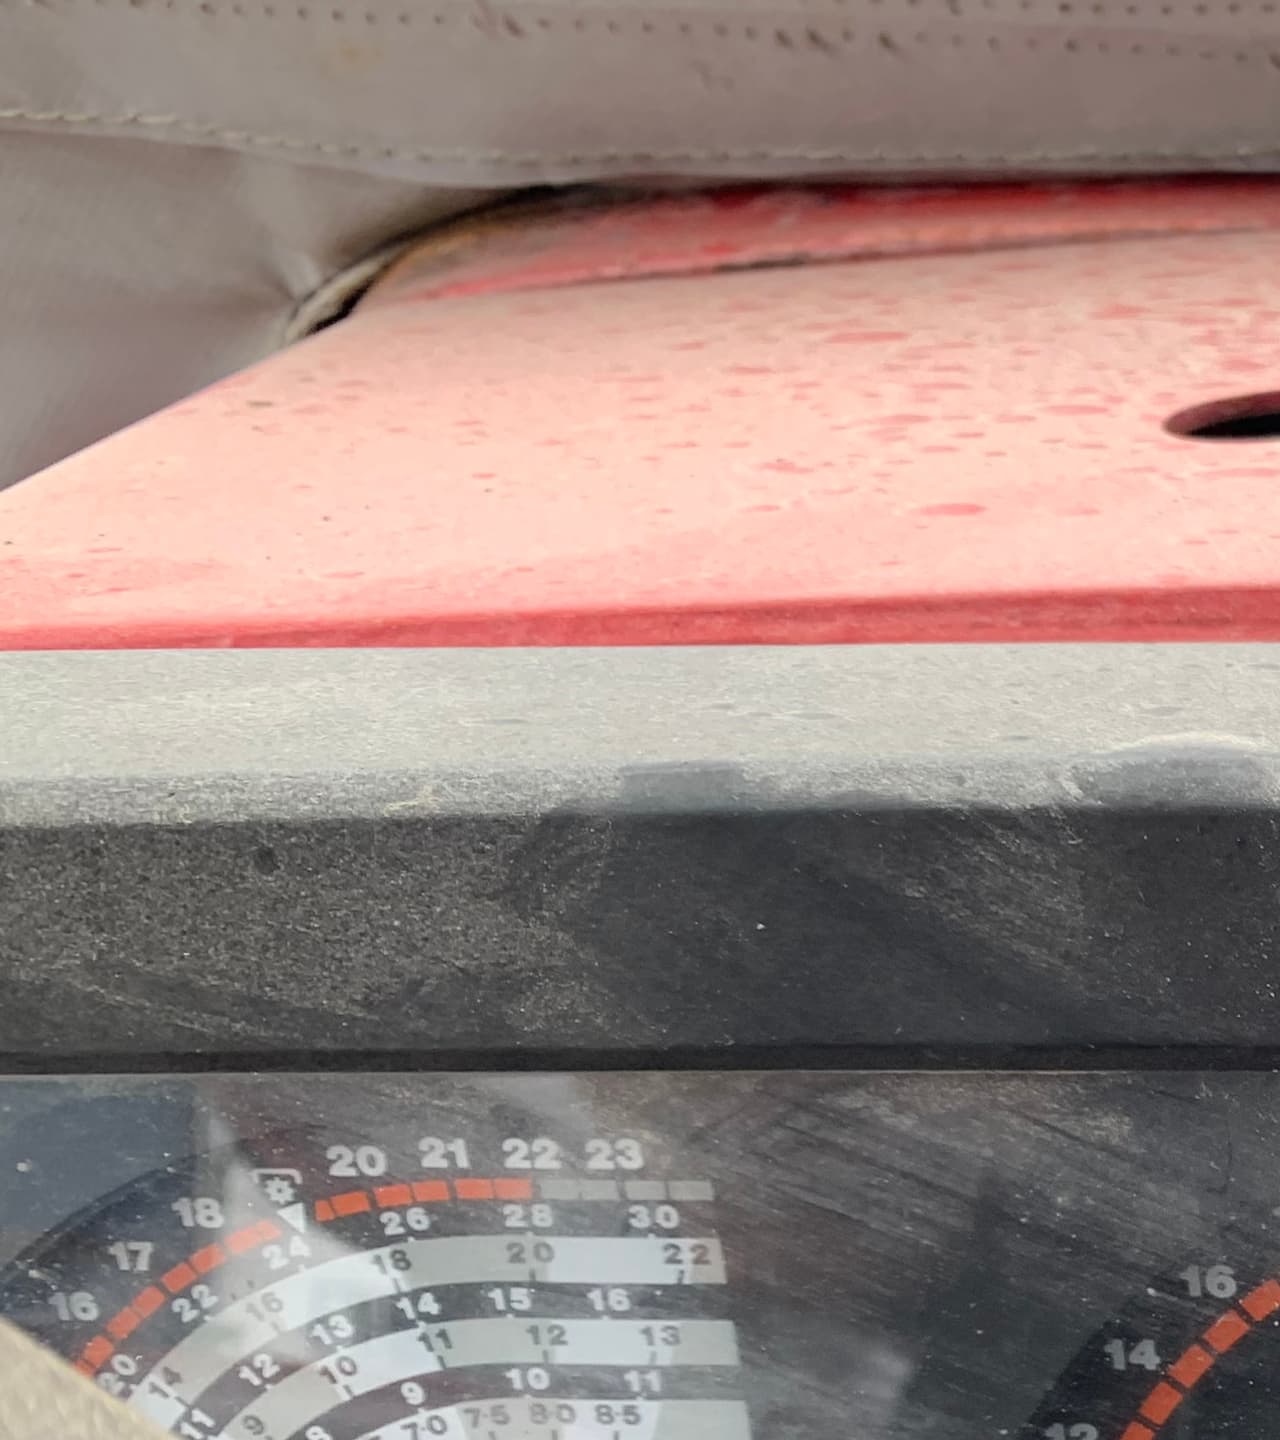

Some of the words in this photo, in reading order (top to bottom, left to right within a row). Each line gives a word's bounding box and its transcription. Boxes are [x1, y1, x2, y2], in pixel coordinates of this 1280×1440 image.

[48, 1292, 98, 1320] 16
[109, 1242, 154, 1272] 17
[172, 1198, 224, 1228] 18
[327, 1146, 387, 1177] 20
[418, 1138, 470, 1169] 21
[502, 1138, 562, 1169] 22
[585, 1139, 644, 1169] 23
[172, 1284, 218, 1324] 22
[263, 1235, 311, 1269] 24
[381, 1207, 431, 1235] 26
[503, 1204, 554, 1228] 28
[628, 1205, 680, 1228] 30
[149, 1366, 182, 1398] 14
[246, 1292, 283, 1321] 16
[373, 1249, 411, 1275] 18
[505, 1242, 555, 1264] 20
[664, 1243, 711, 1265] 22
[181, 1409, 216, 1440] 11
[239, 1354, 280, 1386] 12
[312, 1315, 354, 1345] 13
[396, 1293, 440, 1320] 14
[488, 1288, 532, 1311] 15
[587, 1289, 631, 1311] 16
[1104, 1339, 1160, 1370] 14
[1180, 1265, 1237, 1299] 16
[243, 1416, 264, 1435] 9
[320, 1355, 357, 1383] 10
[418, 1329, 453, 1352] 11
[526, 1325, 568, 1346] 12
[640, 1326, 681, 1346] 13
[402, 1382, 424, 1406] 9
[505, 1368, 550, 1390] 10
[624, 1371, 662, 1392] 11
